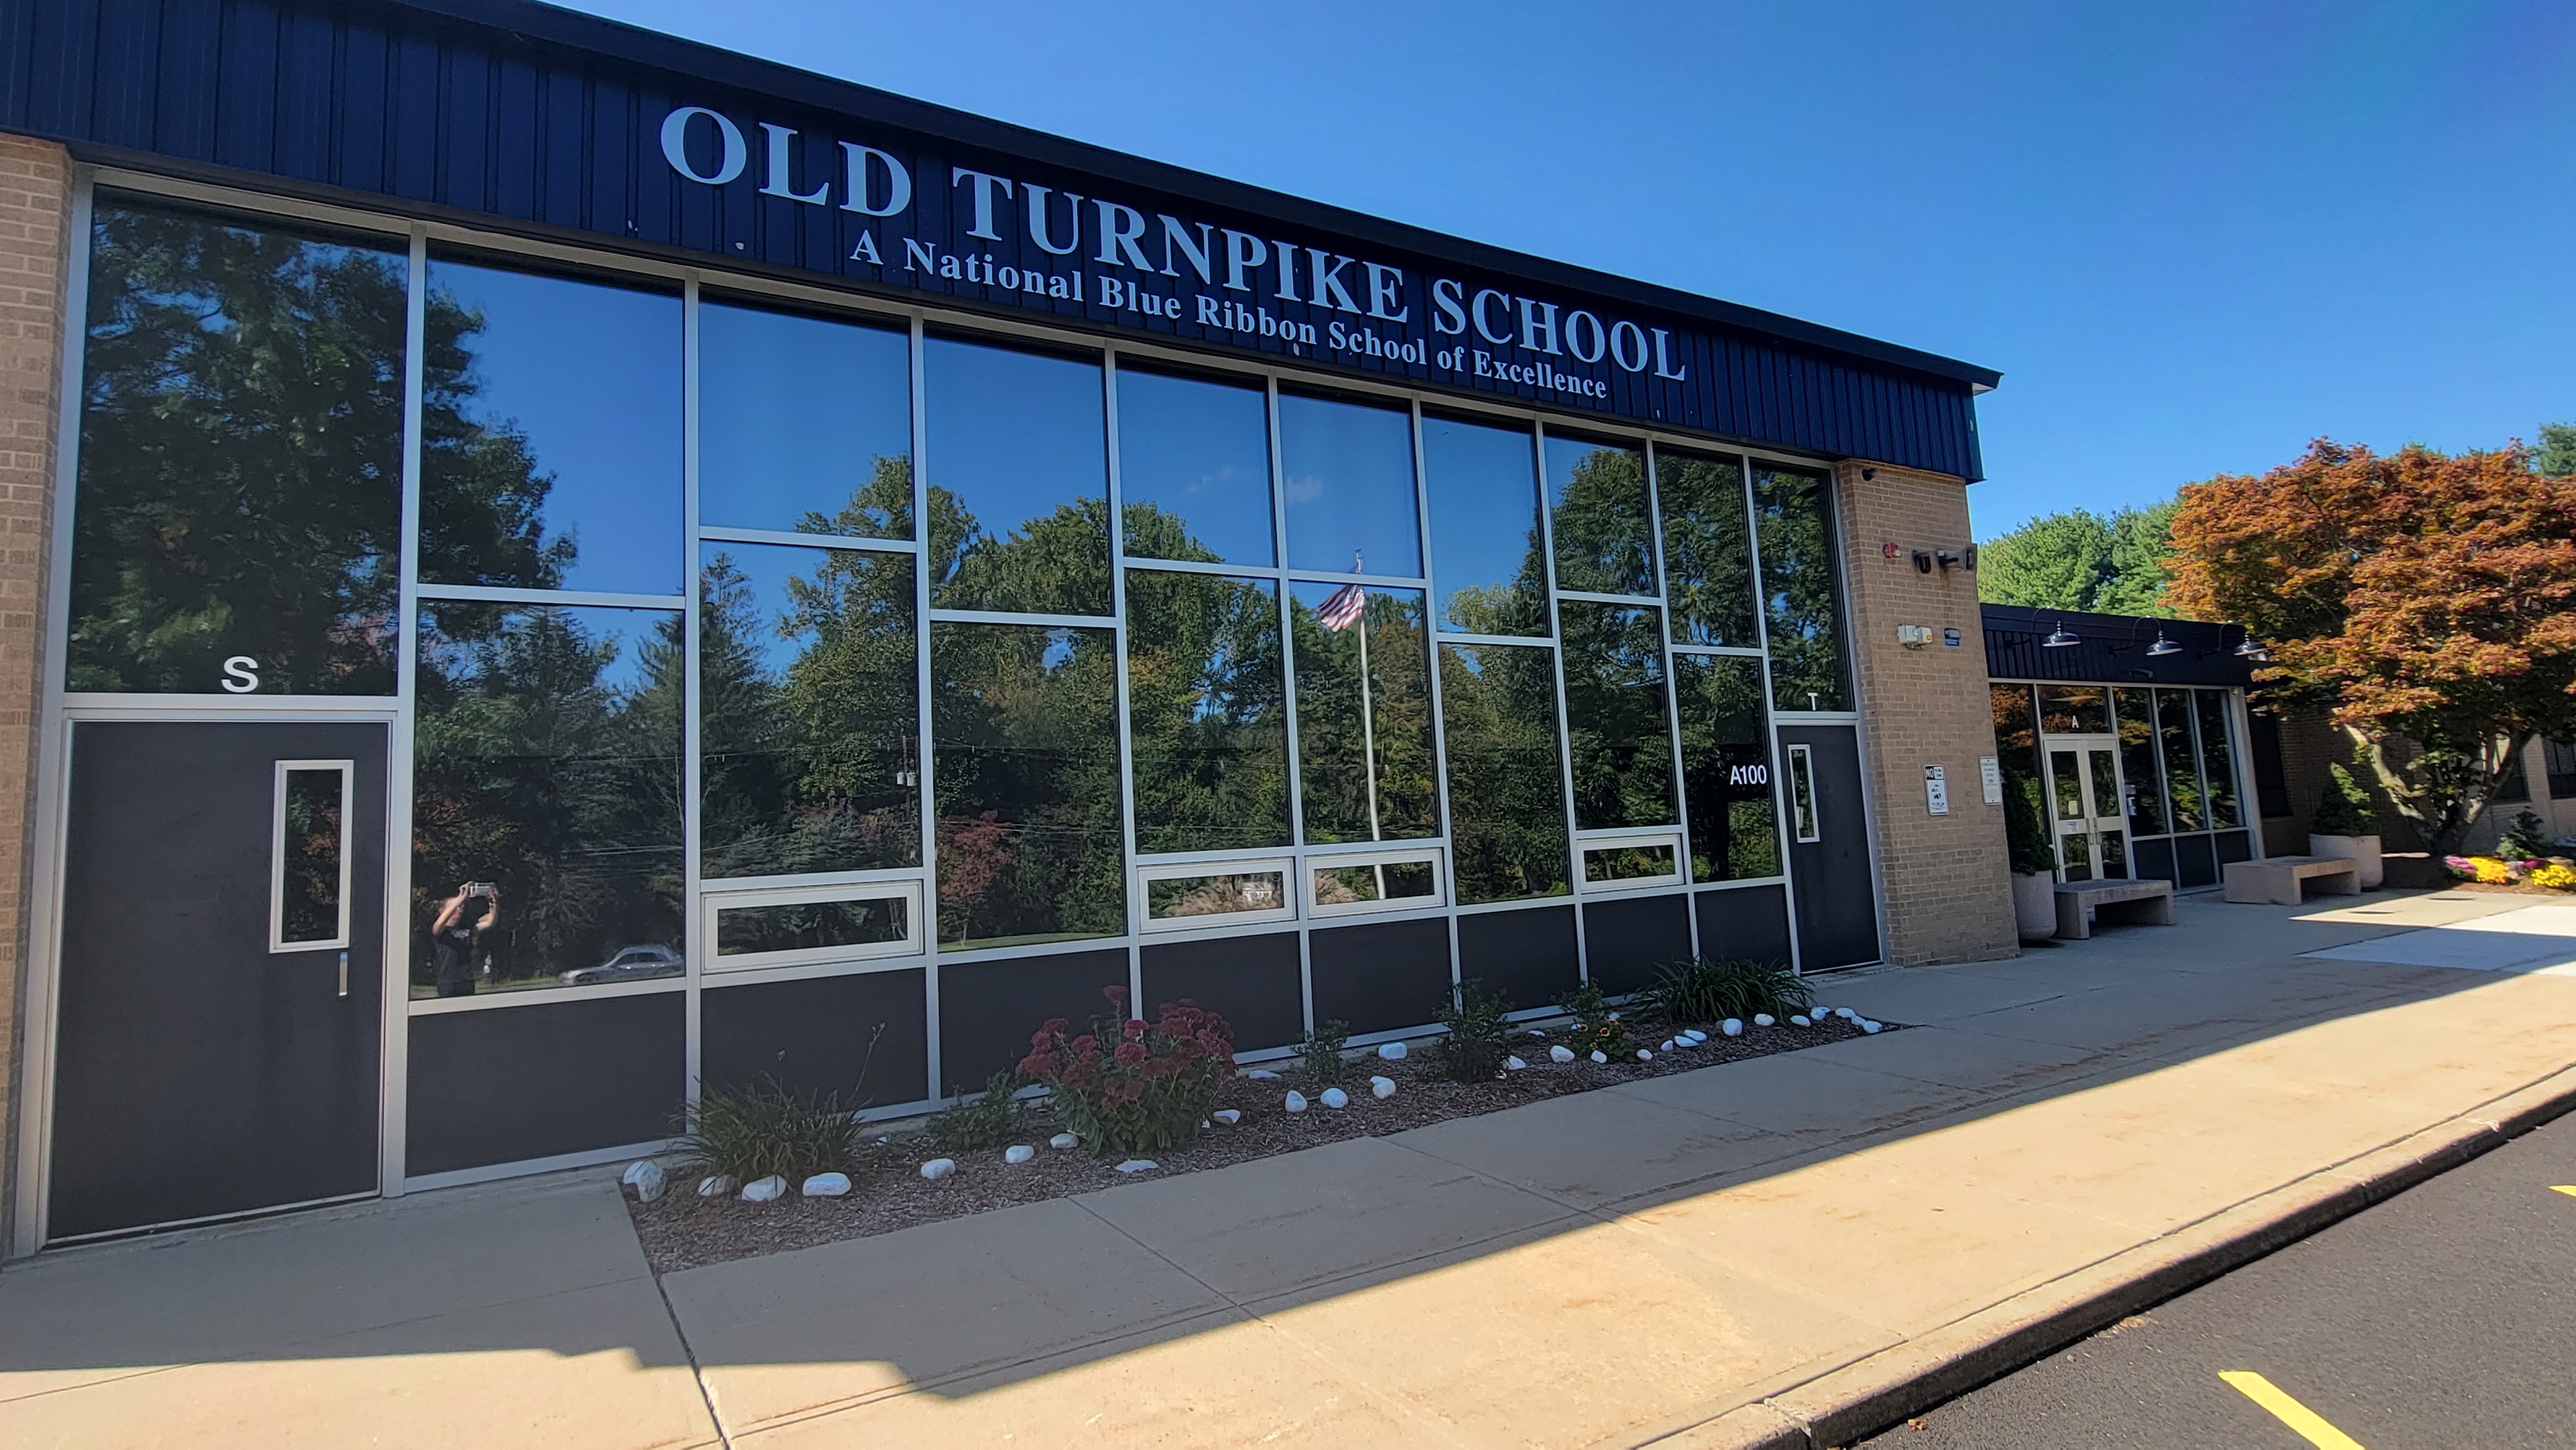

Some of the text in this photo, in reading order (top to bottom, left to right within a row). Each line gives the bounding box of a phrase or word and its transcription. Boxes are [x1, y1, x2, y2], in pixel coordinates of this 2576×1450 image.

[661, 106, 1685, 381] OLD TURNPIKE SCHOOL
[849, 229, 1607, 399] A National Blue Ribbon School of Excellence
[221, 655, 258, 693] S
[1808, 693, 1817, 710] T
[2072, 715, 2079, 728] A
[1730, 764, 1767, 785] A100
[1926, 768, 1934, 778] NO
